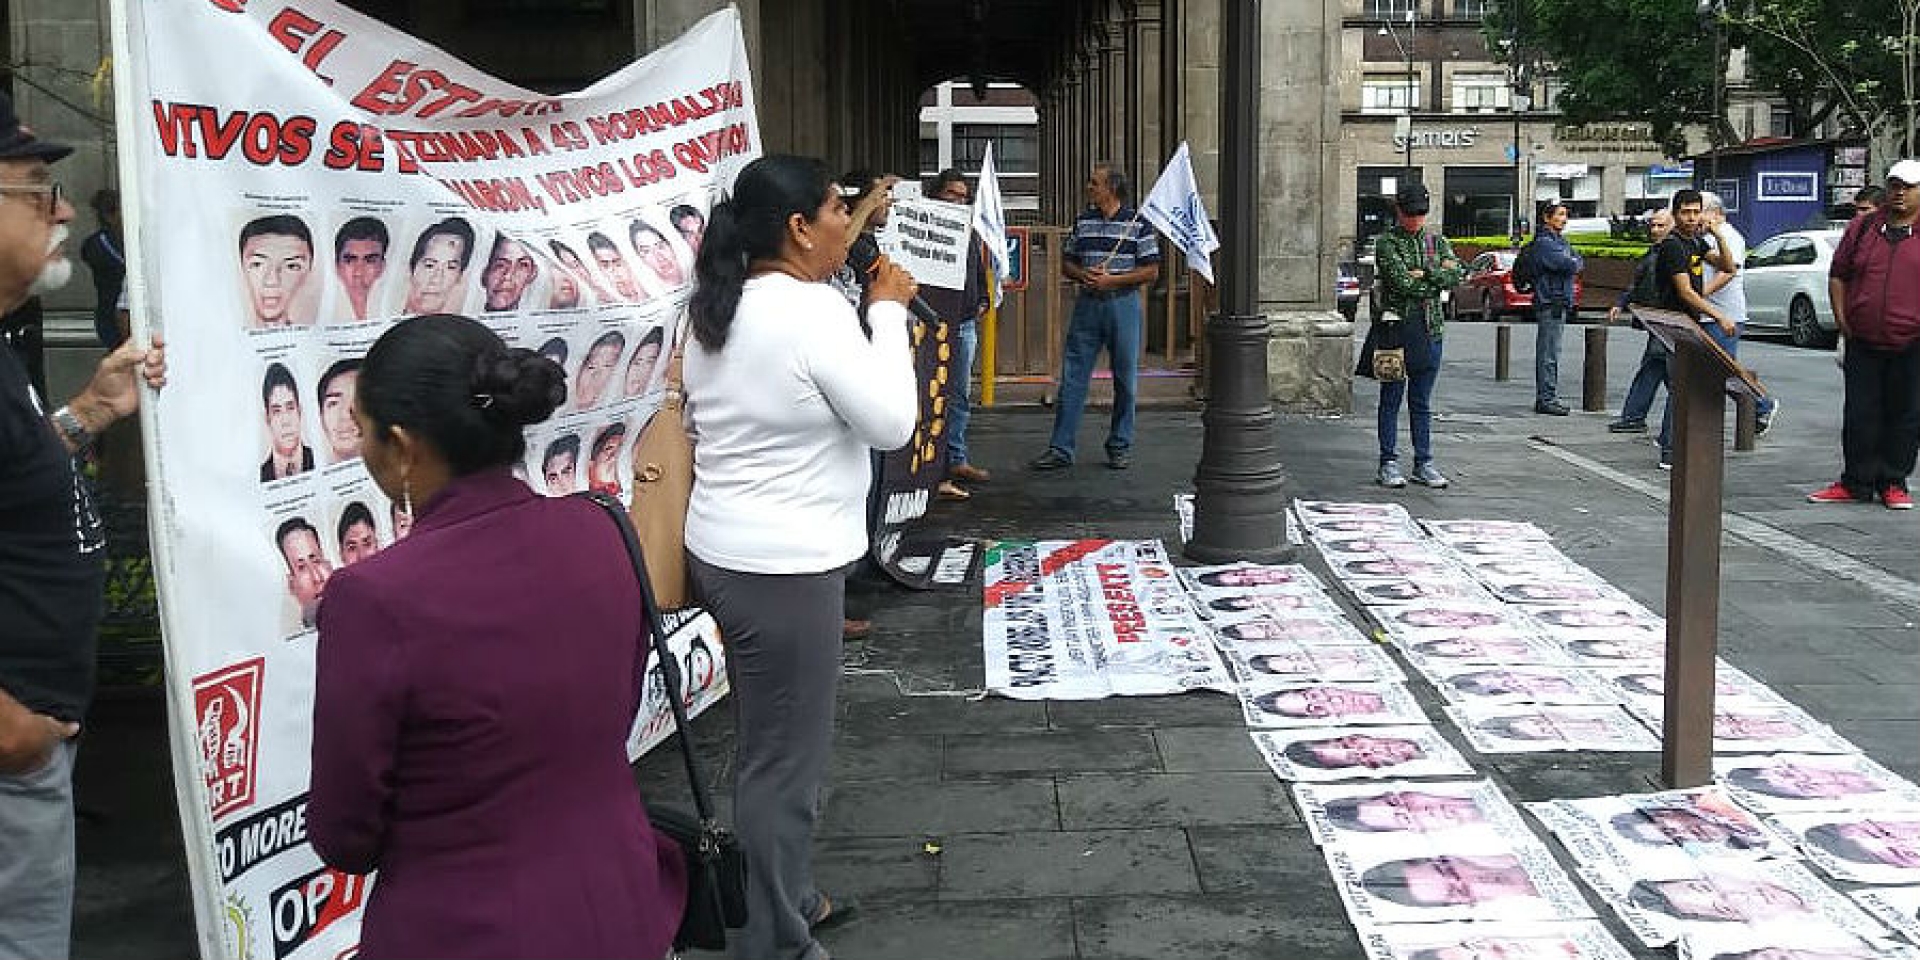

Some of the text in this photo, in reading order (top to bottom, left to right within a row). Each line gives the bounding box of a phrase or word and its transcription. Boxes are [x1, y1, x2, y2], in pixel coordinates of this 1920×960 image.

[152, 99, 385, 173] VIVOS SE
[617, 149, 677, 188] LOS
[240, 803, 308, 867] MORE
